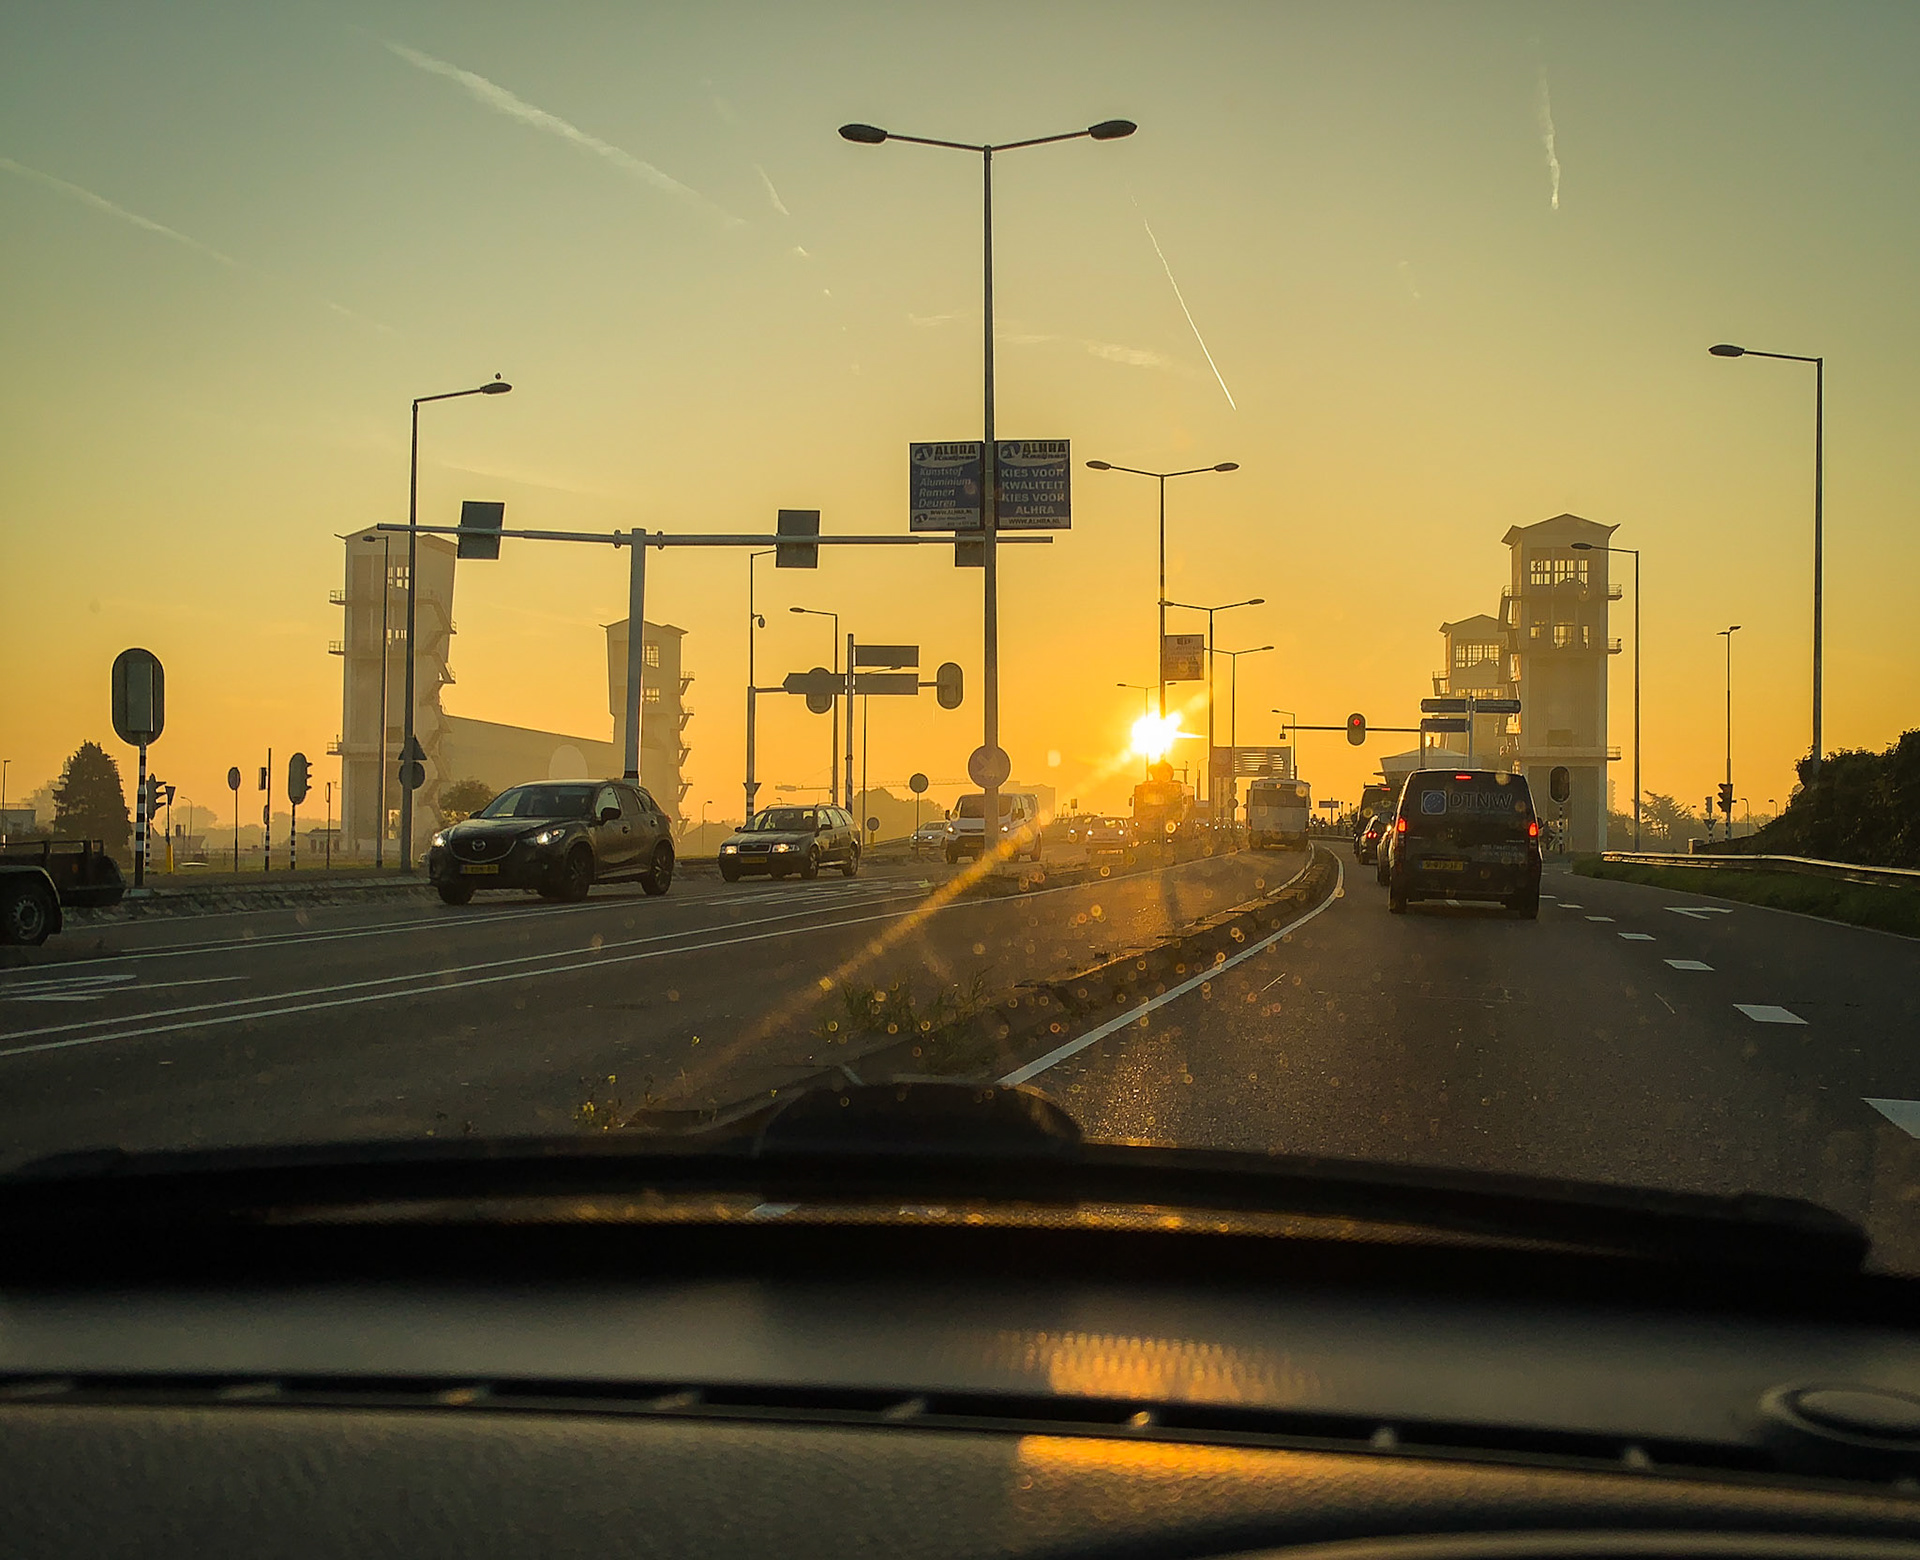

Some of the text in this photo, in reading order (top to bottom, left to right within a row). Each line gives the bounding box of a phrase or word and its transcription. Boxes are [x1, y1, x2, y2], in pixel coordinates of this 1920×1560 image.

[935, 445, 976, 455] ALHRA
[1023, 443, 1066, 453] ALHRA
[920, 467, 963, 477] Kunststof
[1001, 468, 1064, 477] KIES VOOR
[920, 478, 971, 487] Aluminium
[1002, 481, 1065, 490] KWALITEIT
[919, 488, 955, 497] Ramen
[1002, 493, 1065, 502] KIES VOOR
[919, 498, 956, 508] Deuren
[1015, 505, 1055, 514] ALHRA
[1448, 792, 1513, 809] DTNW
